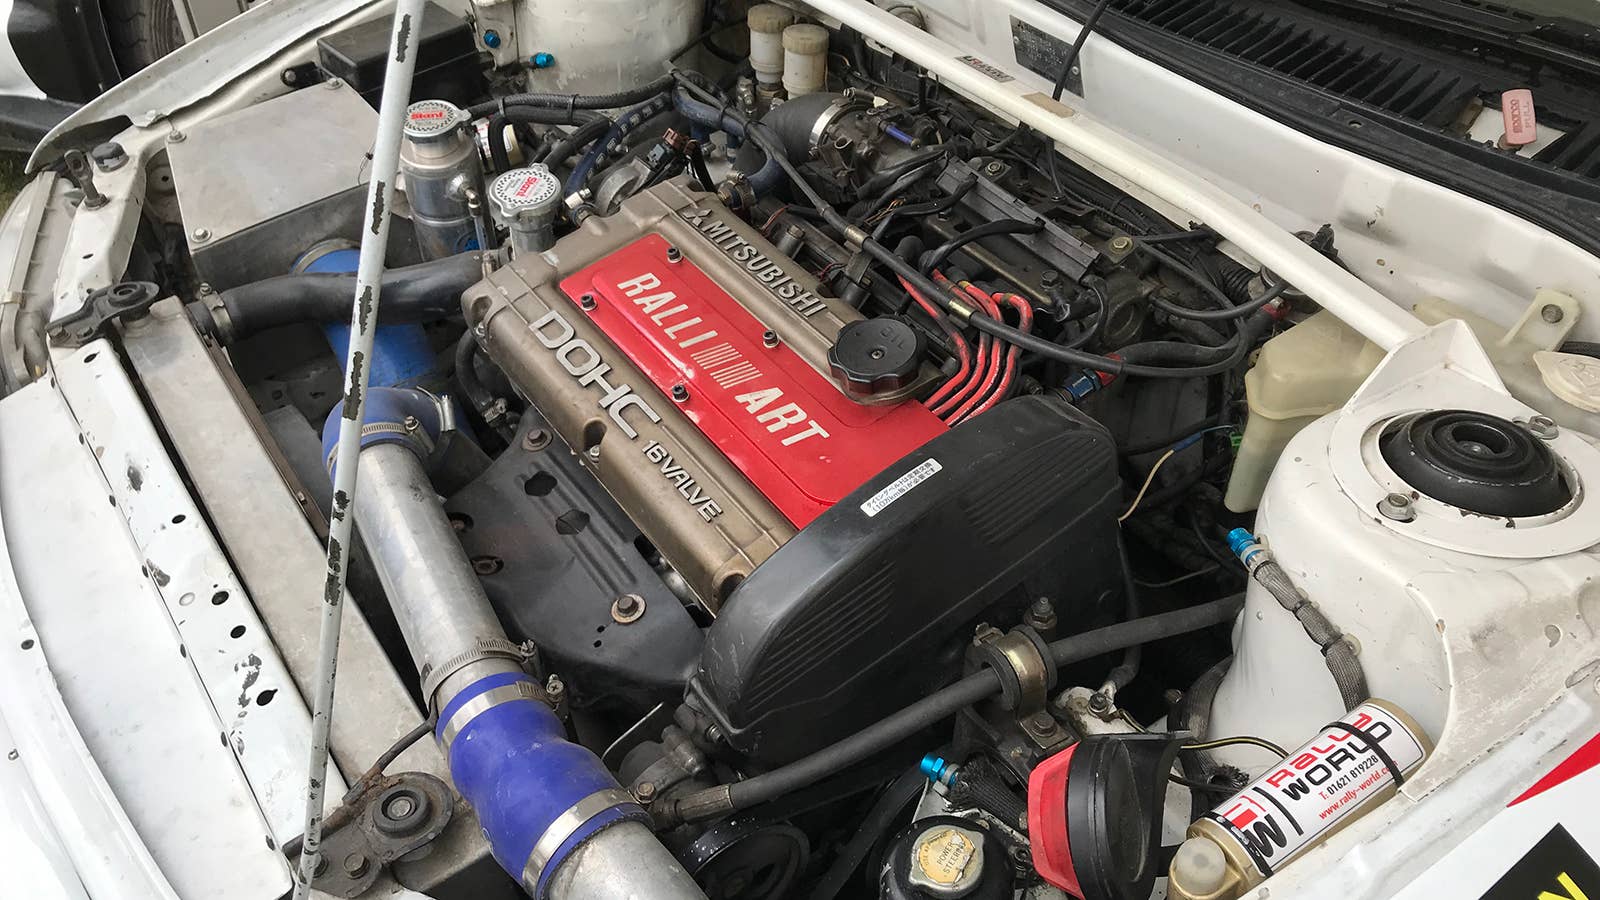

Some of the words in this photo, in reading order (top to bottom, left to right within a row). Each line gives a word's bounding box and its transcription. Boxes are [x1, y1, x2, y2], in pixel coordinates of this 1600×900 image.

[701, 220, 828, 318] MITSUBISHI
[528, 310, 662, 440] DOHC
[617, 272, 718, 349] RALLI
[735, 387, 831, 447] ART
[1281, 721, 1393, 801] WORLD
[1318, 791, 1328, 800] T:
[1326, 774, 1351, 795] 01621
[1349, 755, 1379, 779] 819228
[937, 843, 954, 865] POWER
